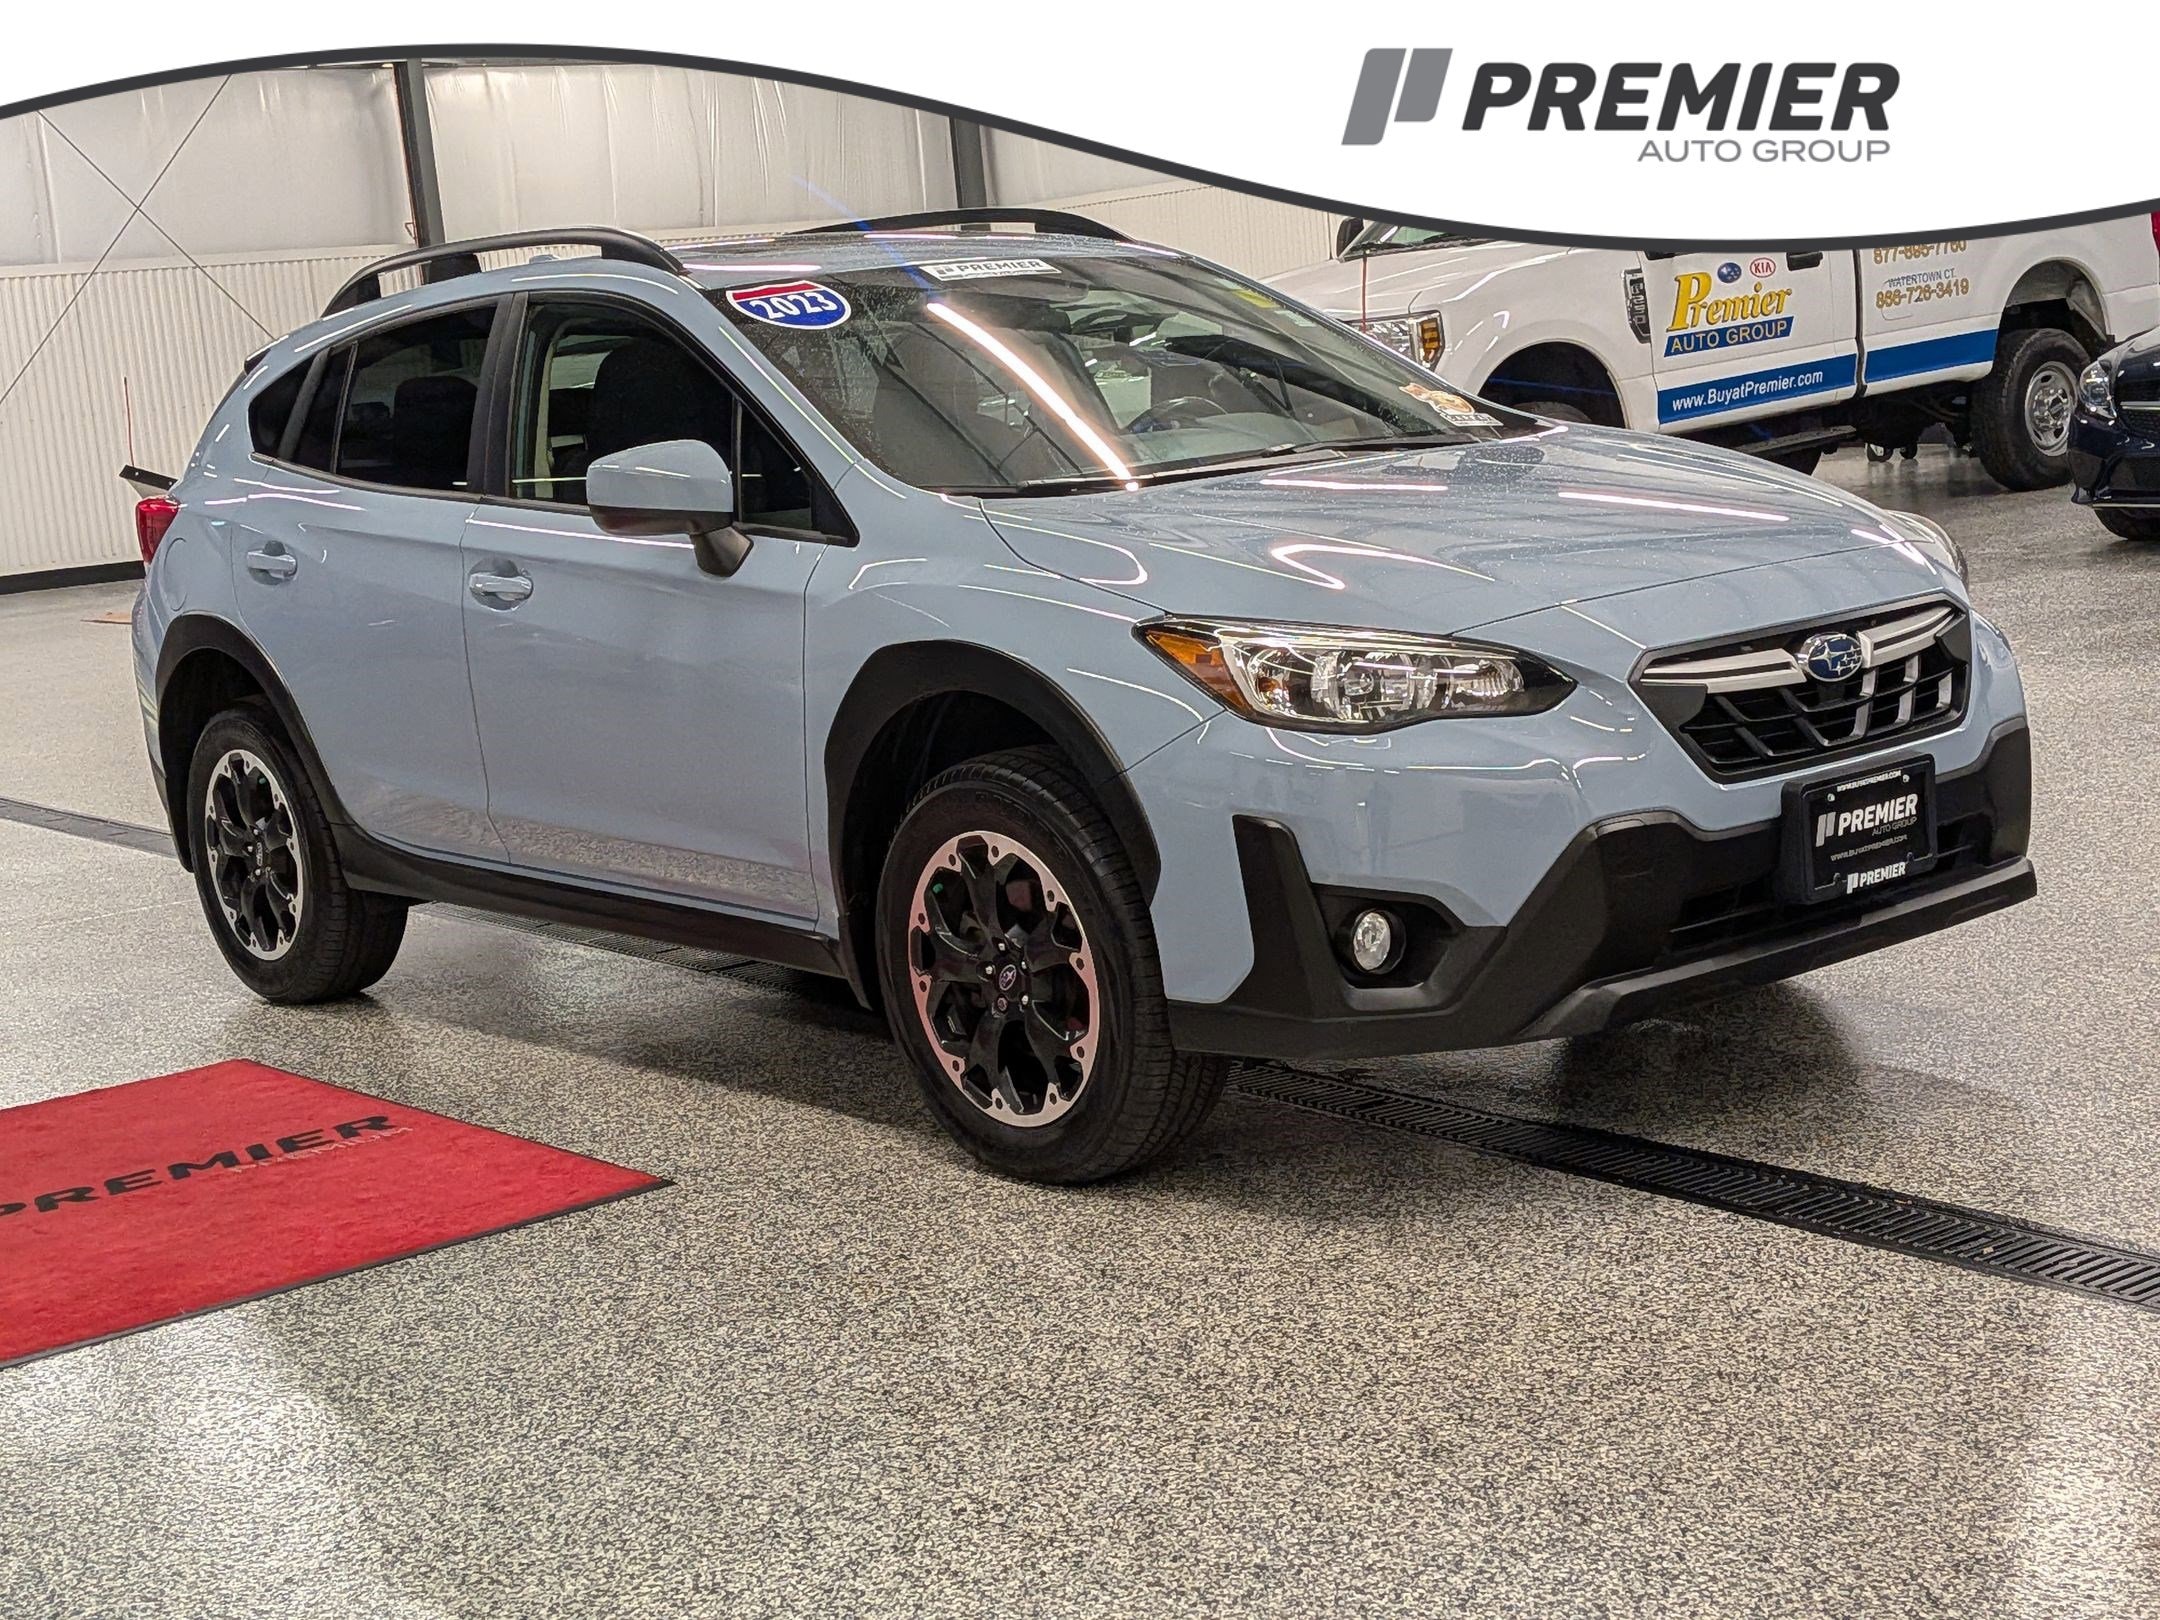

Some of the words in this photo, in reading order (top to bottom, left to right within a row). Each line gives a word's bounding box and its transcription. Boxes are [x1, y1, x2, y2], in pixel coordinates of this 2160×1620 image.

[956, 260, 1043, 272] PREMIER
[1887, 271, 1942, 288] WATERTOWN
[749, 290, 838, 320] 2023
[1666, 271, 1793, 332] Premier
[1671, 331, 1720, 353] AUTO
[1725, 320, 1788, 344] GROUP
[1672, 369, 1824, 412] www.BuyatPremier.com
[1838, 793, 1919, 837] PREMIER
[1871, 823, 1892, 836] AUTO
[1892, 816, 1918, 830] GROUP
[1859, 861, 1906, 888] PREMIER
